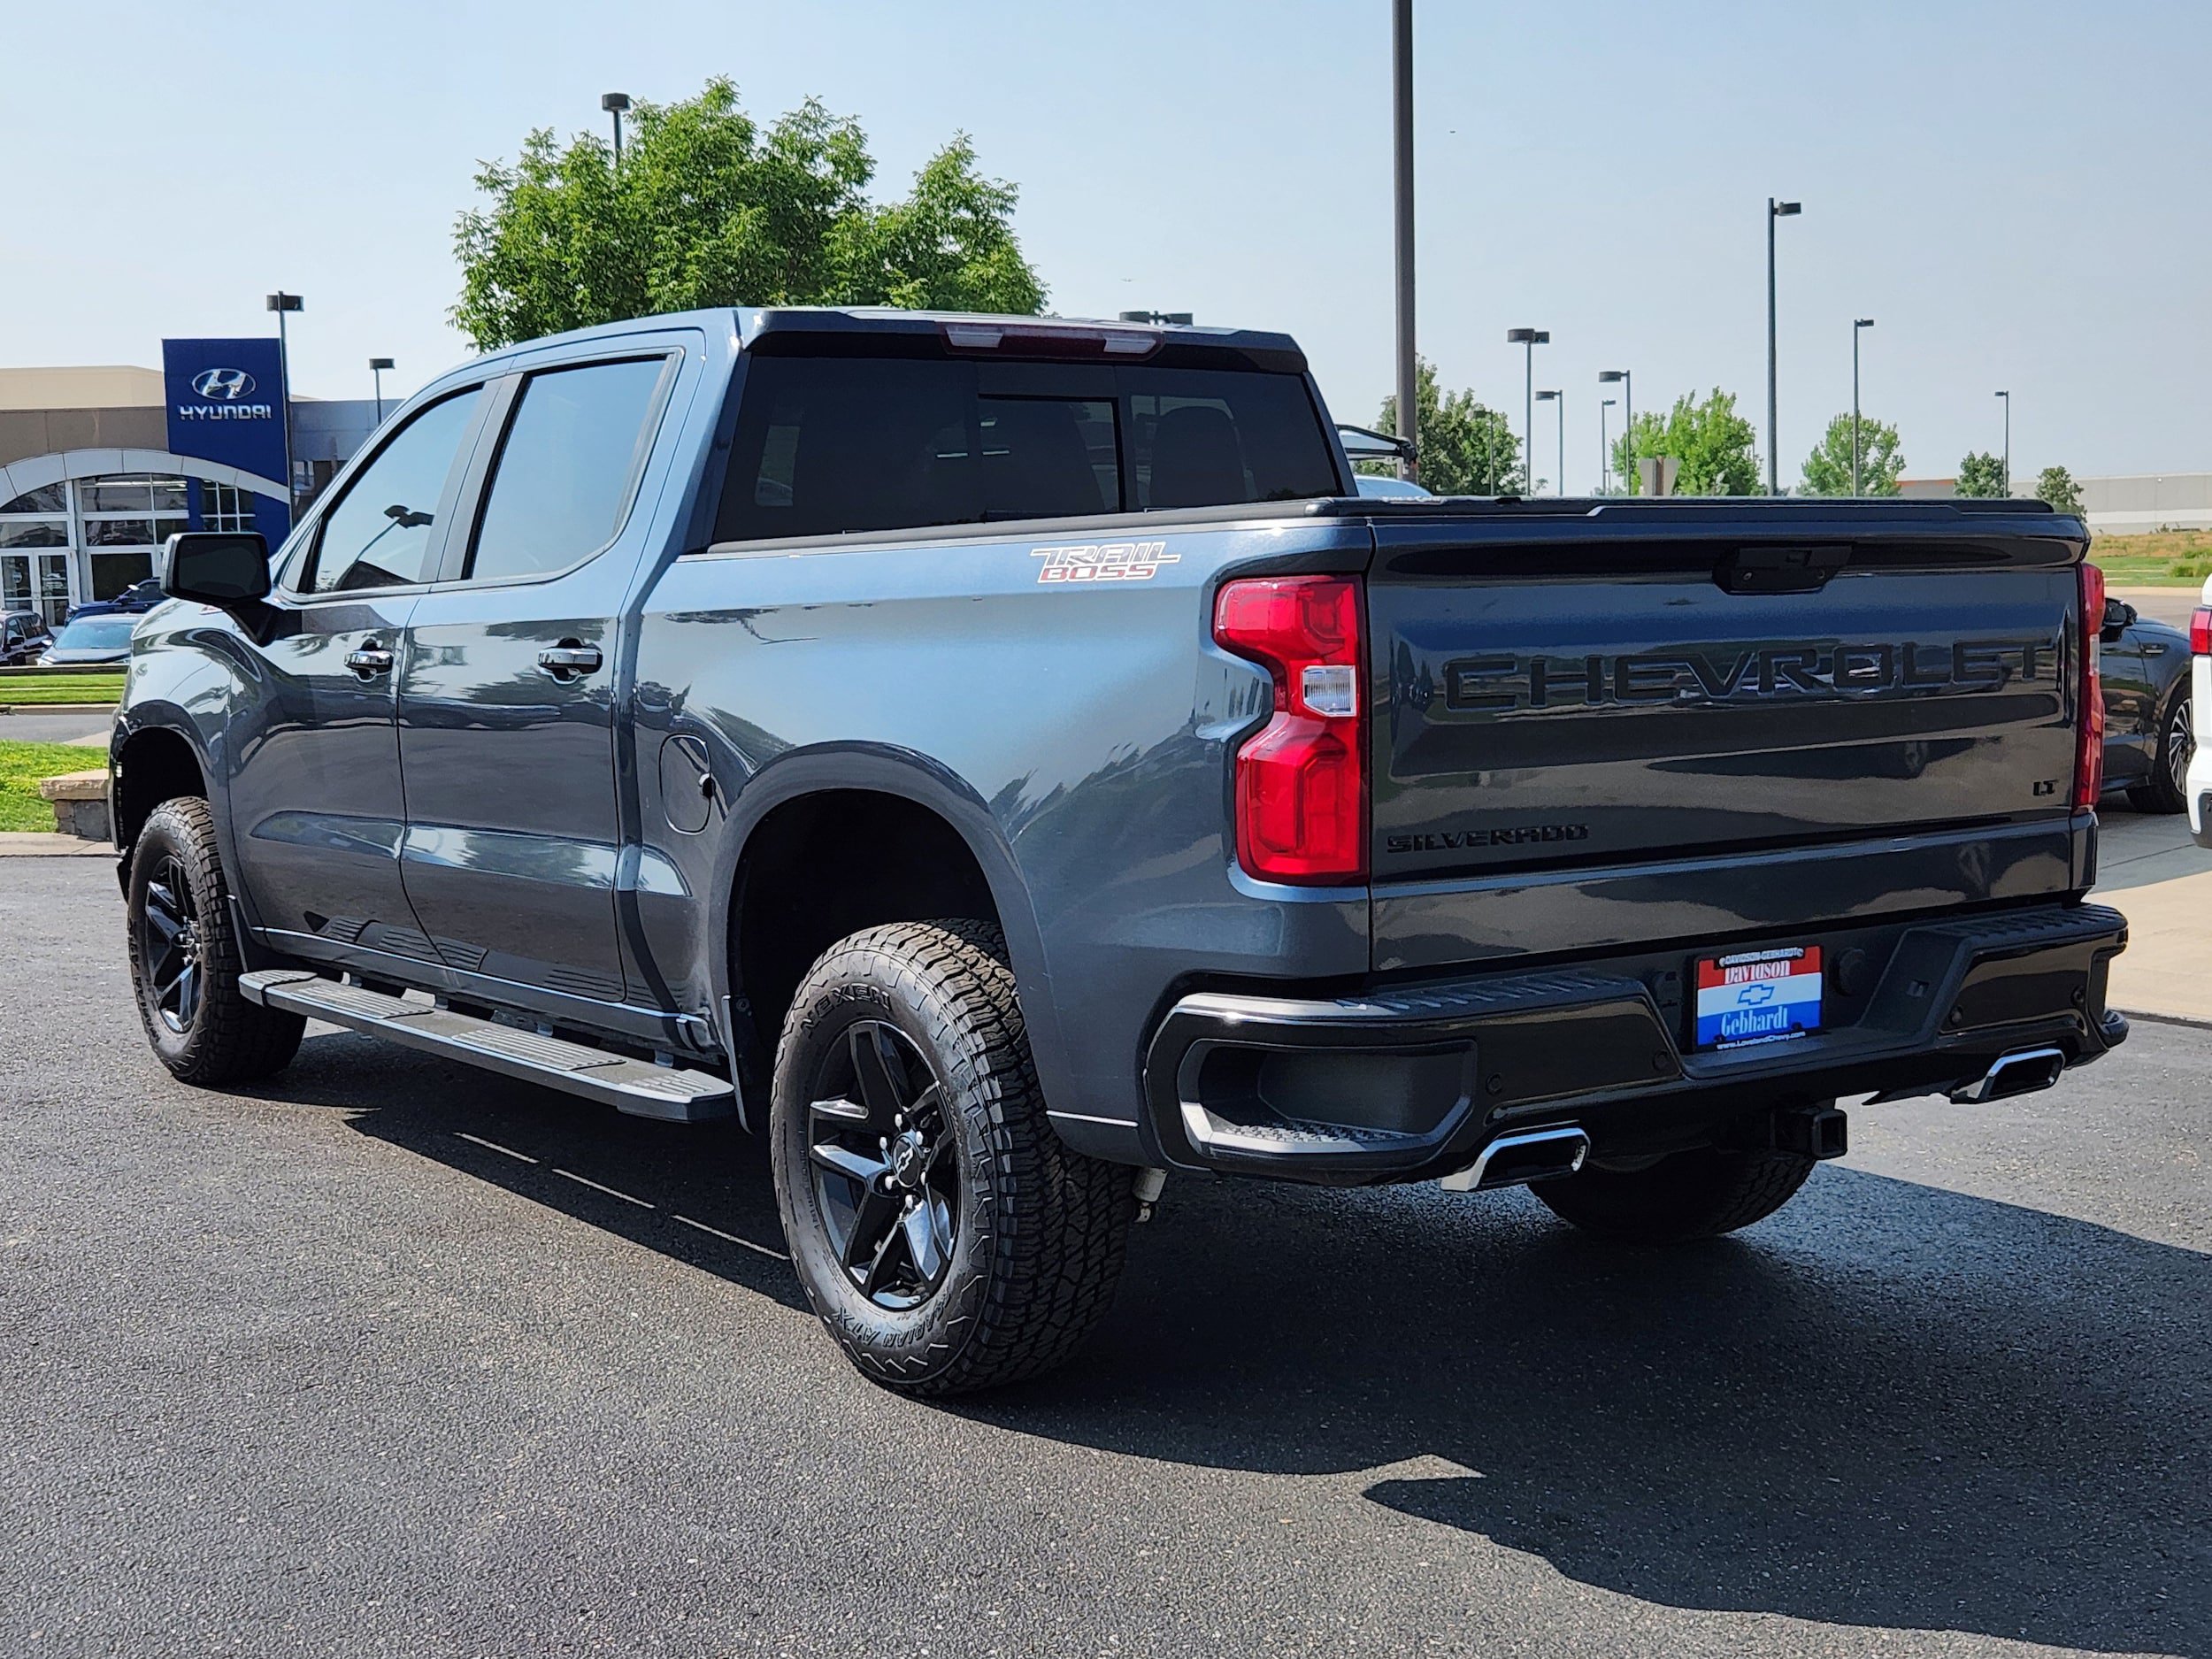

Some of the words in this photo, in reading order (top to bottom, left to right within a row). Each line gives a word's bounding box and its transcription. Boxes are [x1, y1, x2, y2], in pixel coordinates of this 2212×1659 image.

[179, 404, 272, 420] HYUNDAI
[1030, 541, 1181, 566] TRAIL
[1037, 563, 1156, 583] BOSS
[1445, 638, 2054, 710] CHEVROLET
[2033, 780, 2059, 796] LT
[1386, 823, 1589, 854] SILVERADO
[1724, 960, 1791, 985] Davidson
[800, 982, 894, 1040] NEXEN
[1721, 1005, 1788, 1037] Gebhardt
